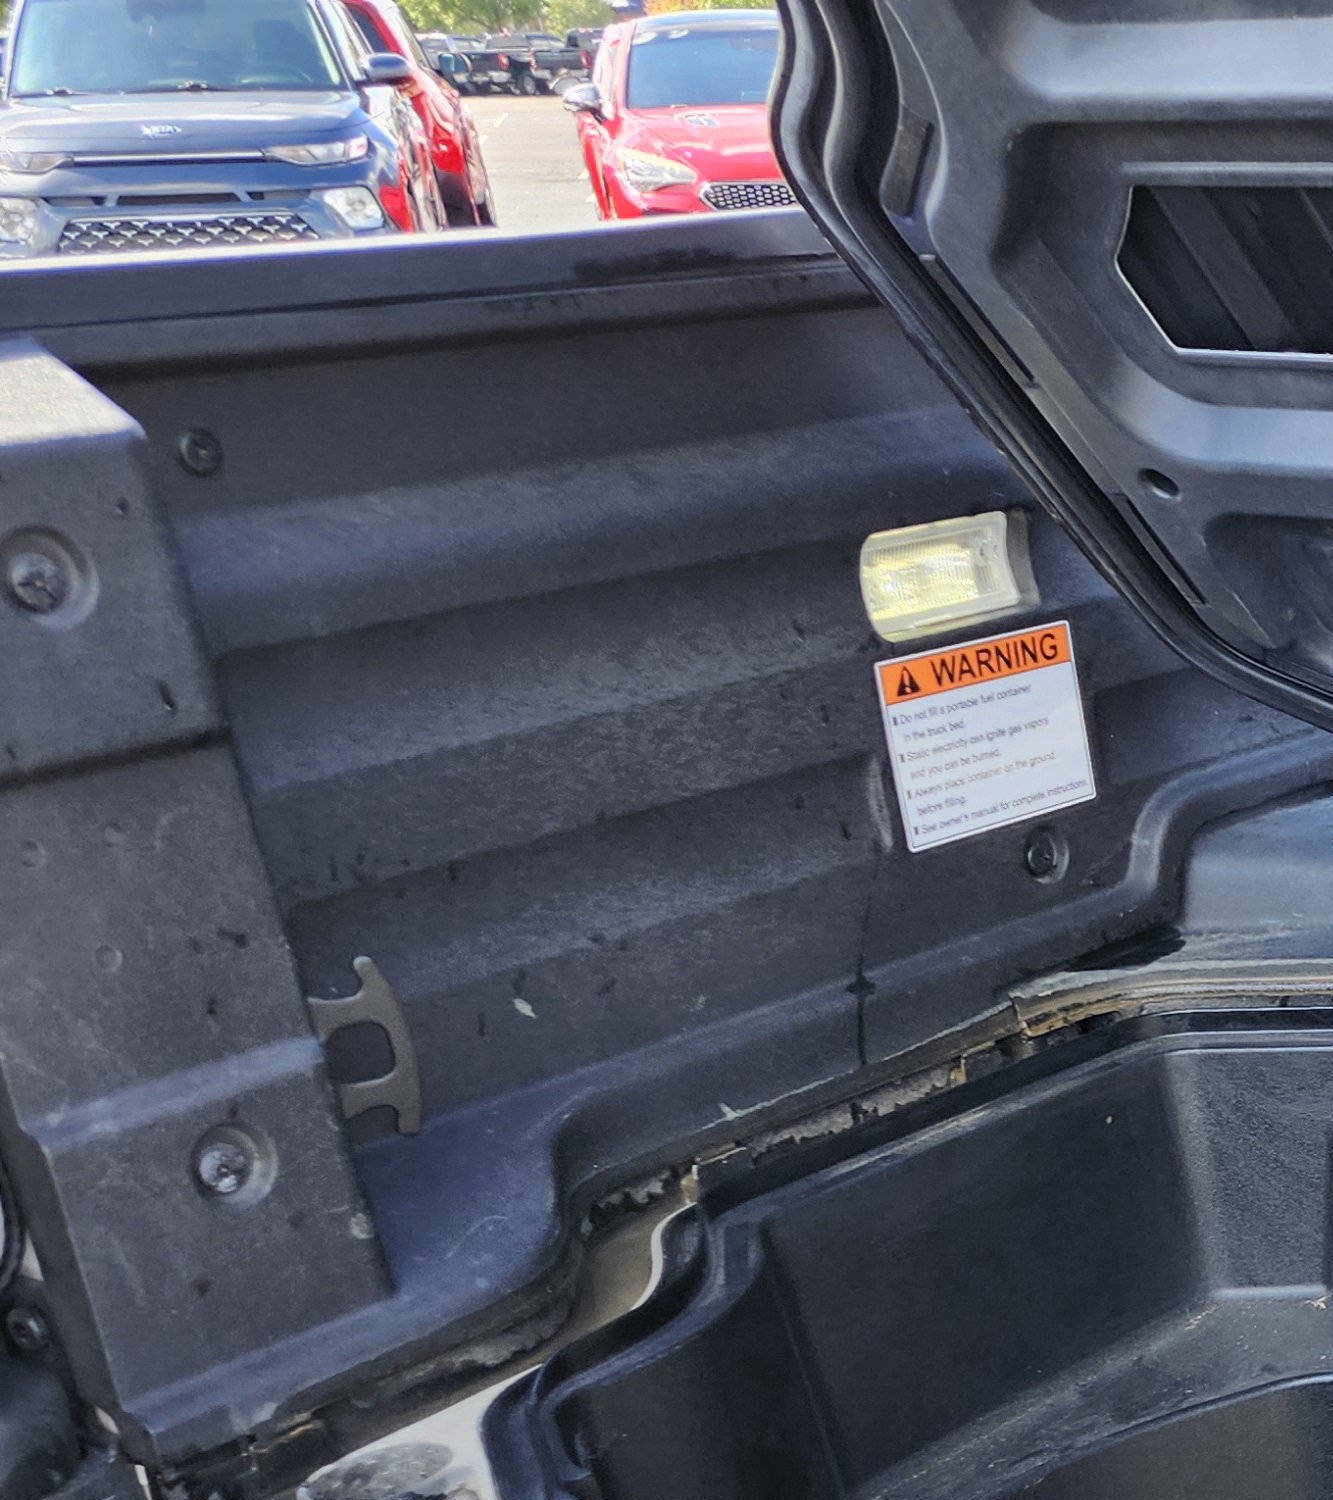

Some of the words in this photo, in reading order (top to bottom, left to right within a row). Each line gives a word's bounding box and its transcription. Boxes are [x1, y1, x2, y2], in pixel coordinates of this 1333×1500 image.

[930, 633, 1058, 687] WARNING
[900, 714, 912, 724] Do
[914, 710, 928, 721] not
[946, 697, 979, 714] portable
[980, 692, 995, 704] fuel
[996, 684, 1032, 700] container
[907, 749, 929, 761] Static
[932, 737, 968, 754] electricity
[969, 734, 984, 744] can
[986, 727, 1006, 742] ignite
[1008, 724, 1022, 737] gas
[912, 729, 925, 739] the
[927, 724, 947, 737] truck
[910, 768, 925, 779] and
[928, 765, 942, 777] you
[945, 760, 958, 770] can
[959, 755, 971, 766] be
[915, 784, 943, 798] Always
[944, 777, 965, 791] place
[967, 765, 1003, 783] container
[1004, 763, 1014, 773] on
[1015, 757, 1027, 768] the
[918, 801, 943, 816] before
[921, 823, 938, 834] See
[939, 813, 969, 830] owner's
[971, 803, 998, 819] manual
[1000, 799, 1011, 811] for
[1012, 790, 1045, 809] complete
